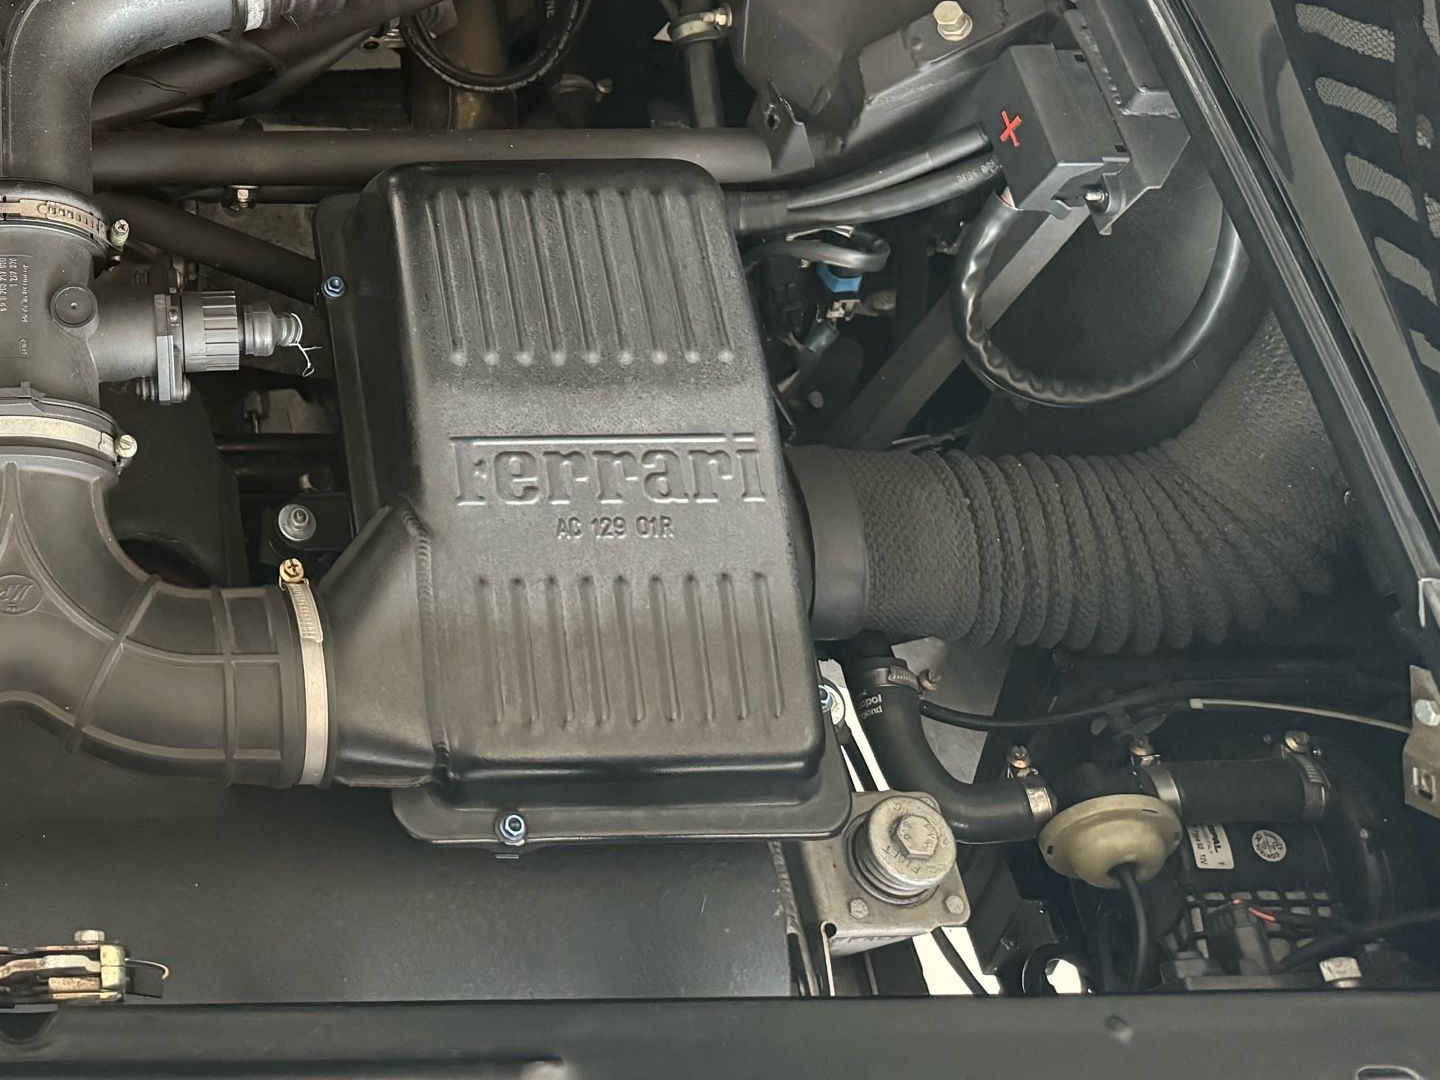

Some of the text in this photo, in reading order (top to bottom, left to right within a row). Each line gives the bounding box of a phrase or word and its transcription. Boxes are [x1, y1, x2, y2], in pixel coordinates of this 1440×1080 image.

[449, 431, 766, 506] Ferrari
[556, 517, 582, 539] AC
[591, 517, 626, 539] 129
